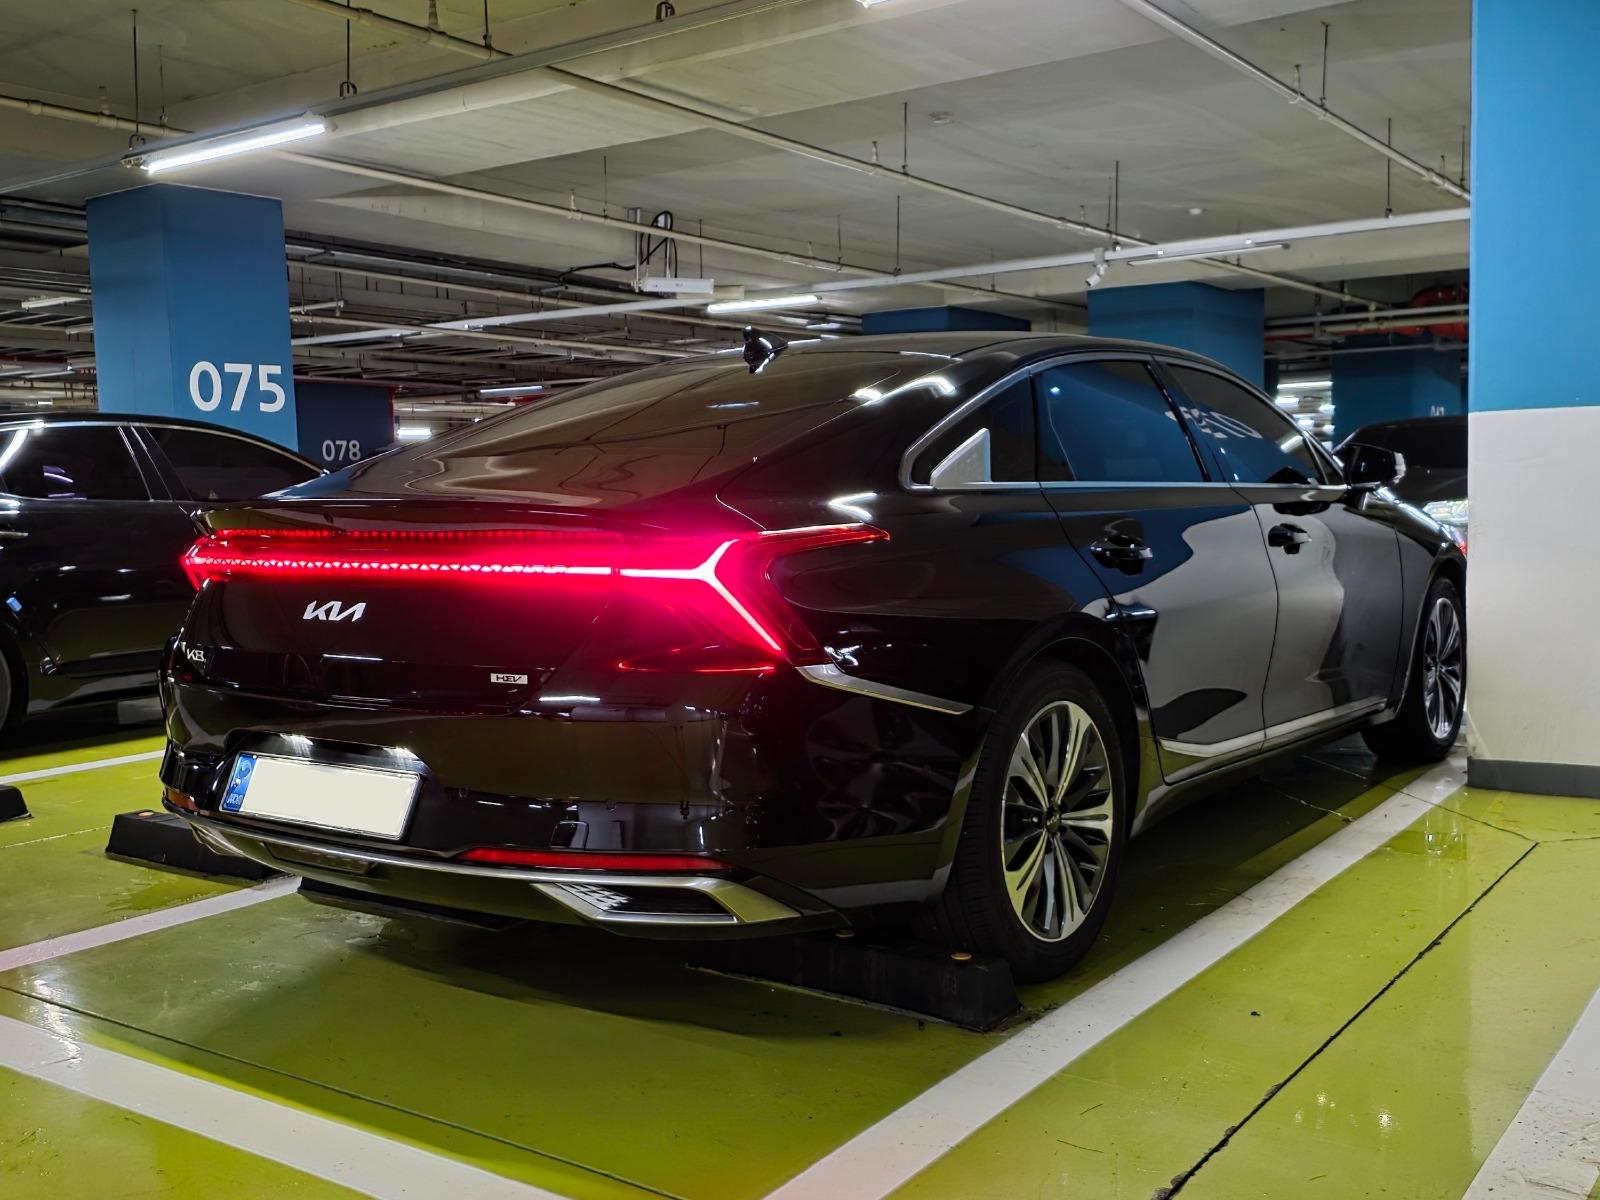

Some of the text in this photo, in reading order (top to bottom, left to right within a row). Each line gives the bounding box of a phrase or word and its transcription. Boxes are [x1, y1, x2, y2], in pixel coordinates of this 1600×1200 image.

[189, 360, 286, 413] 075
[322, 439, 361, 462] 078
[302, 600, 367, 622] KIA
[495, 673, 523, 683] HEV
